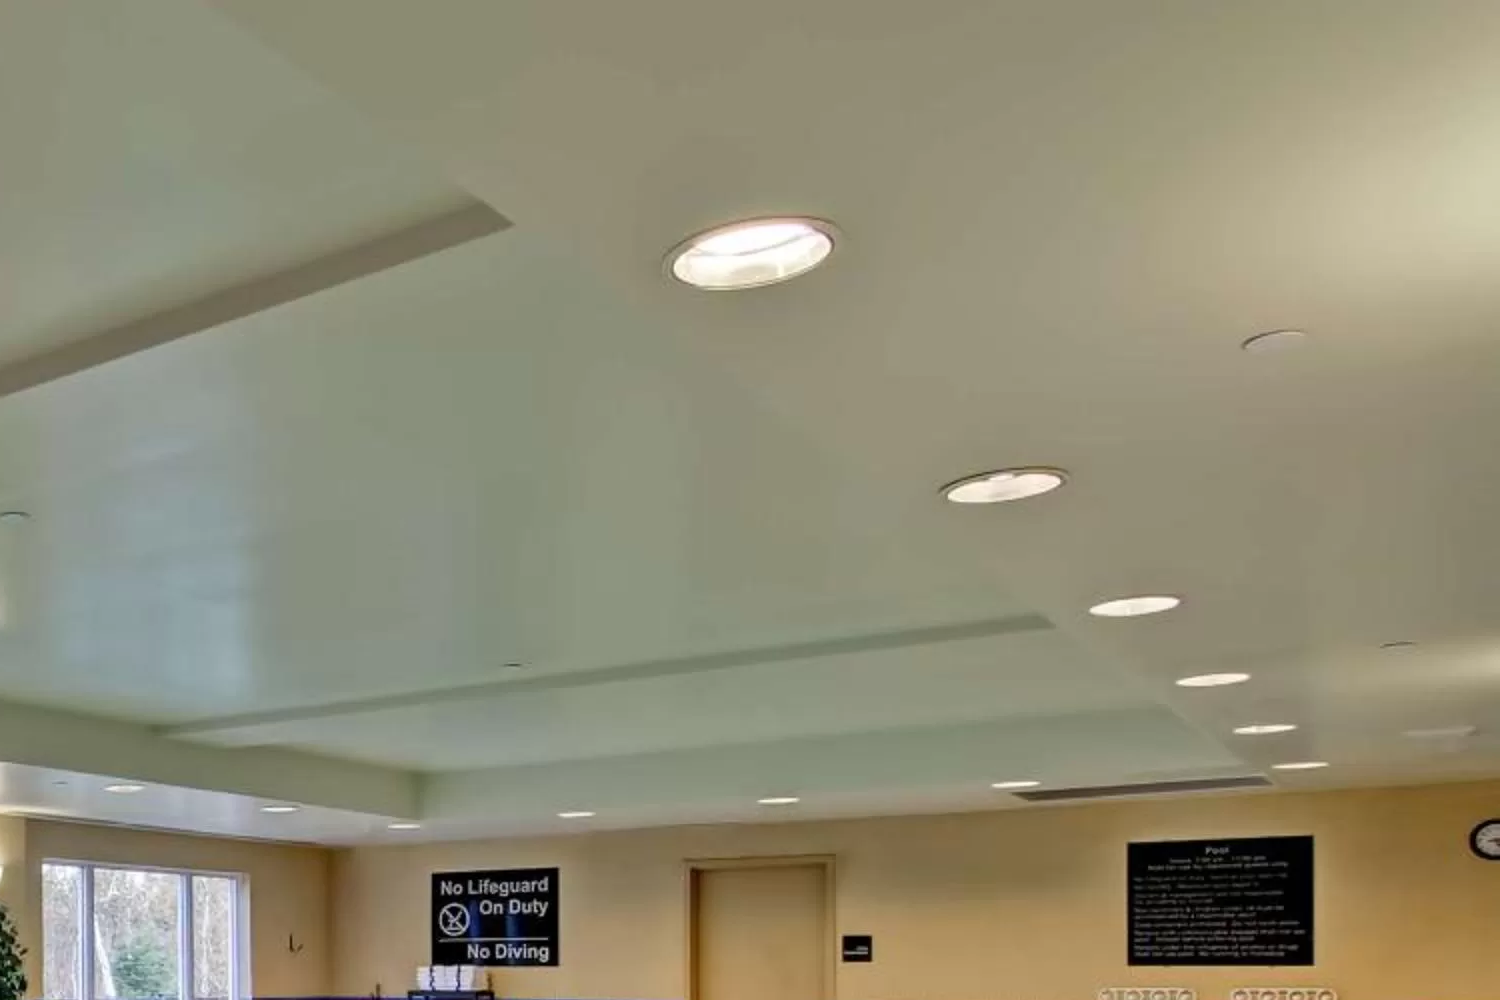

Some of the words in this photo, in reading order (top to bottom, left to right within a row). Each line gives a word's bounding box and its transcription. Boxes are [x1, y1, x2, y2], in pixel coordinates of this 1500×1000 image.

[440, 880, 464, 896] No
[467, 876, 549, 898] Lifeguard
[479, 900, 504, 915] On
[509, 899, 549, 917] Duty
[467, 944, 491, 959] No
[495, 943, 550, 963] Diving
